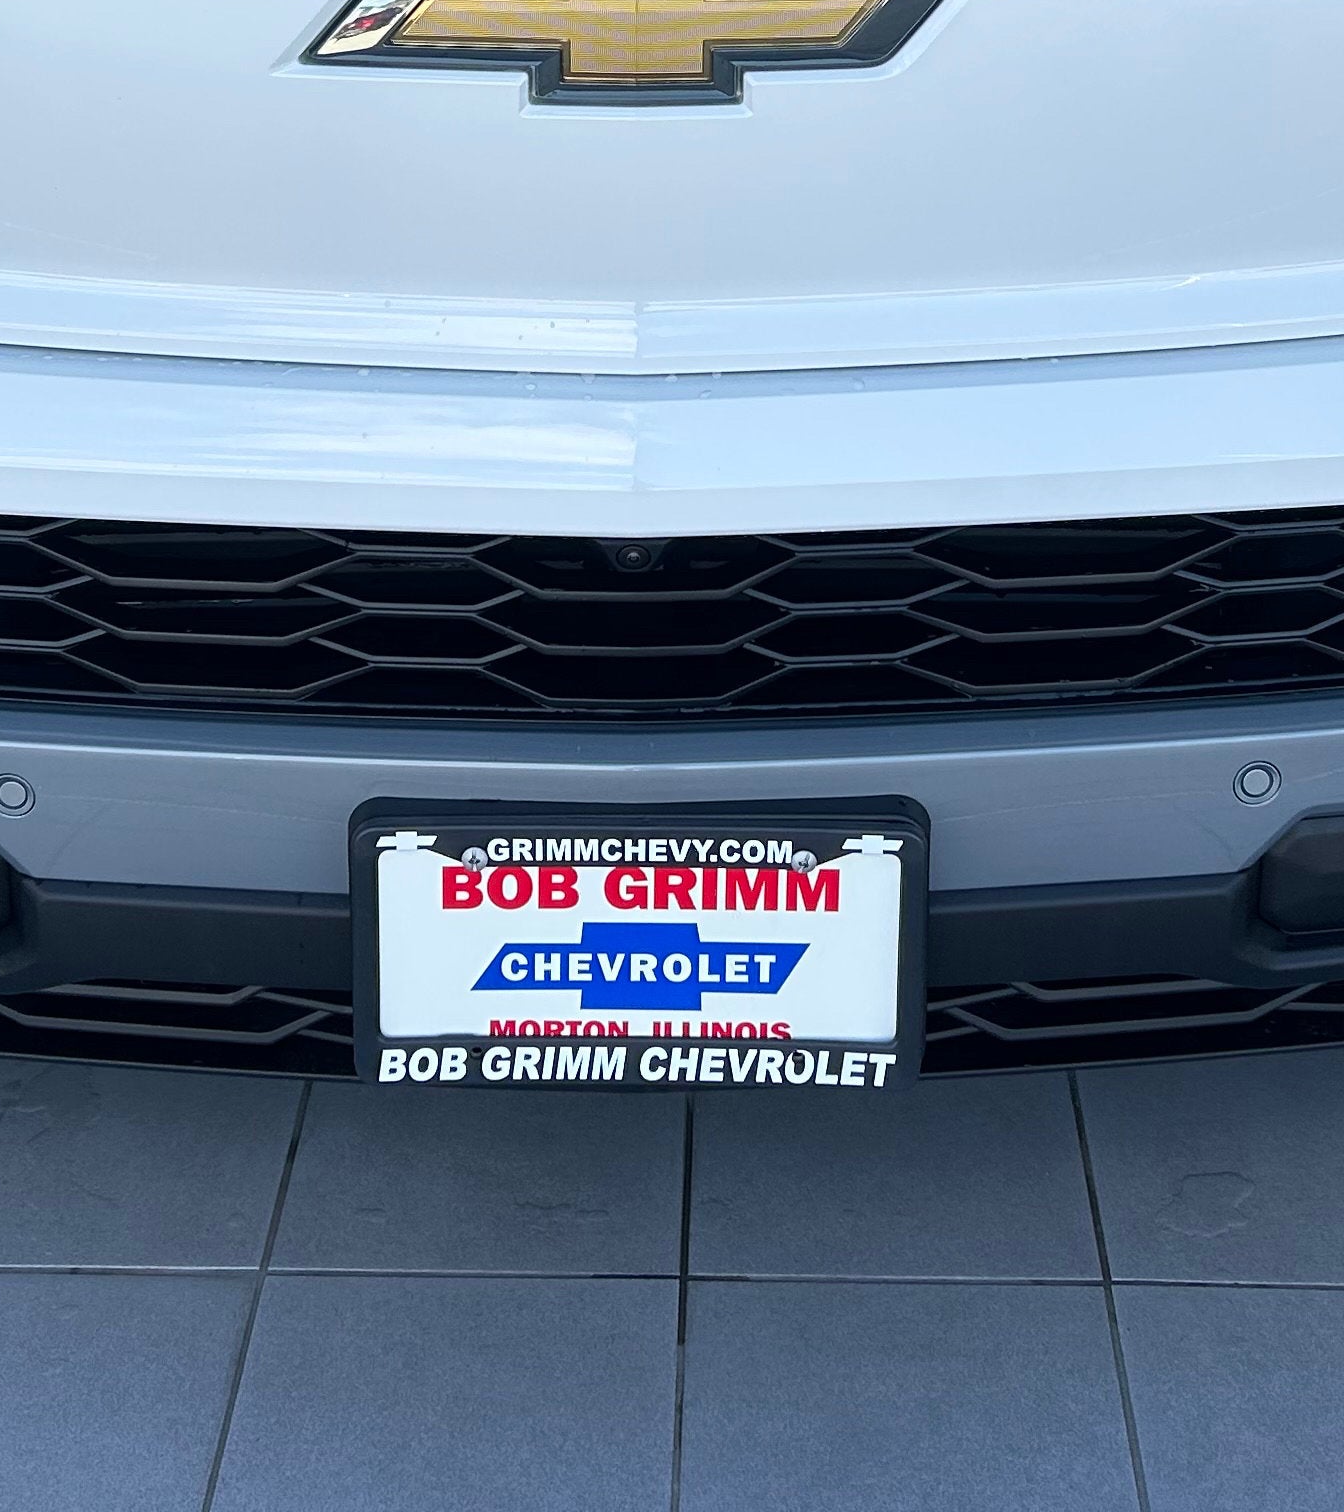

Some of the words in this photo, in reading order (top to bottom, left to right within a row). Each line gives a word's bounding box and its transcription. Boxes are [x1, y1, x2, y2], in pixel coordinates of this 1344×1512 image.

[486, 838, 793, 864] GRIMMCHEVY.COM
[442, 865, 580, 910] BOB
[603, 865, 841, 912] GRIMM
[501, 951, 777, 983] CHEVROLET
[378, 1046, 468, 1083] BOB
[481, 1046, 627, 1082] GRIMM
[639, 1046, 897, 1088] CHEVROLET
